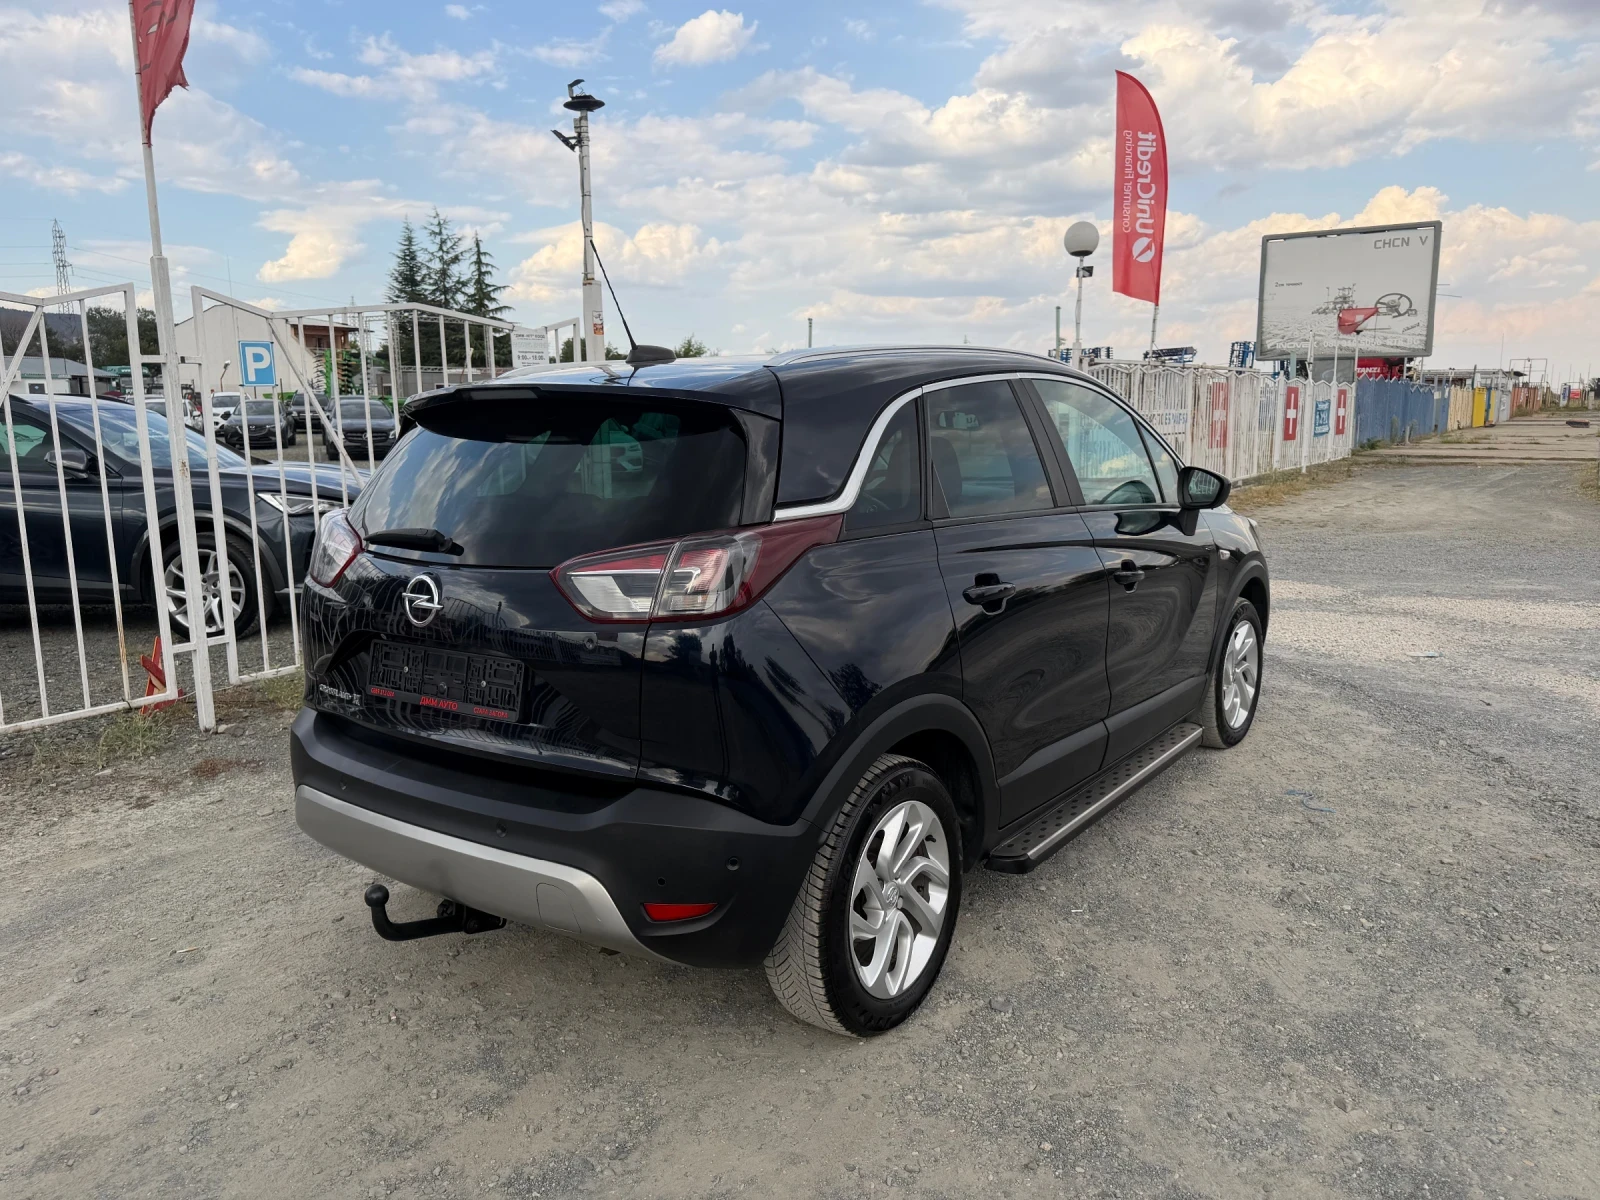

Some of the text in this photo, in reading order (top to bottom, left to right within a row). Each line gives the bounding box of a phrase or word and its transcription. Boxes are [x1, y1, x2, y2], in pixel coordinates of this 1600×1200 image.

[246, 346, 272, 382] P
[420, 696, 458, 711] ДММ АУТО
